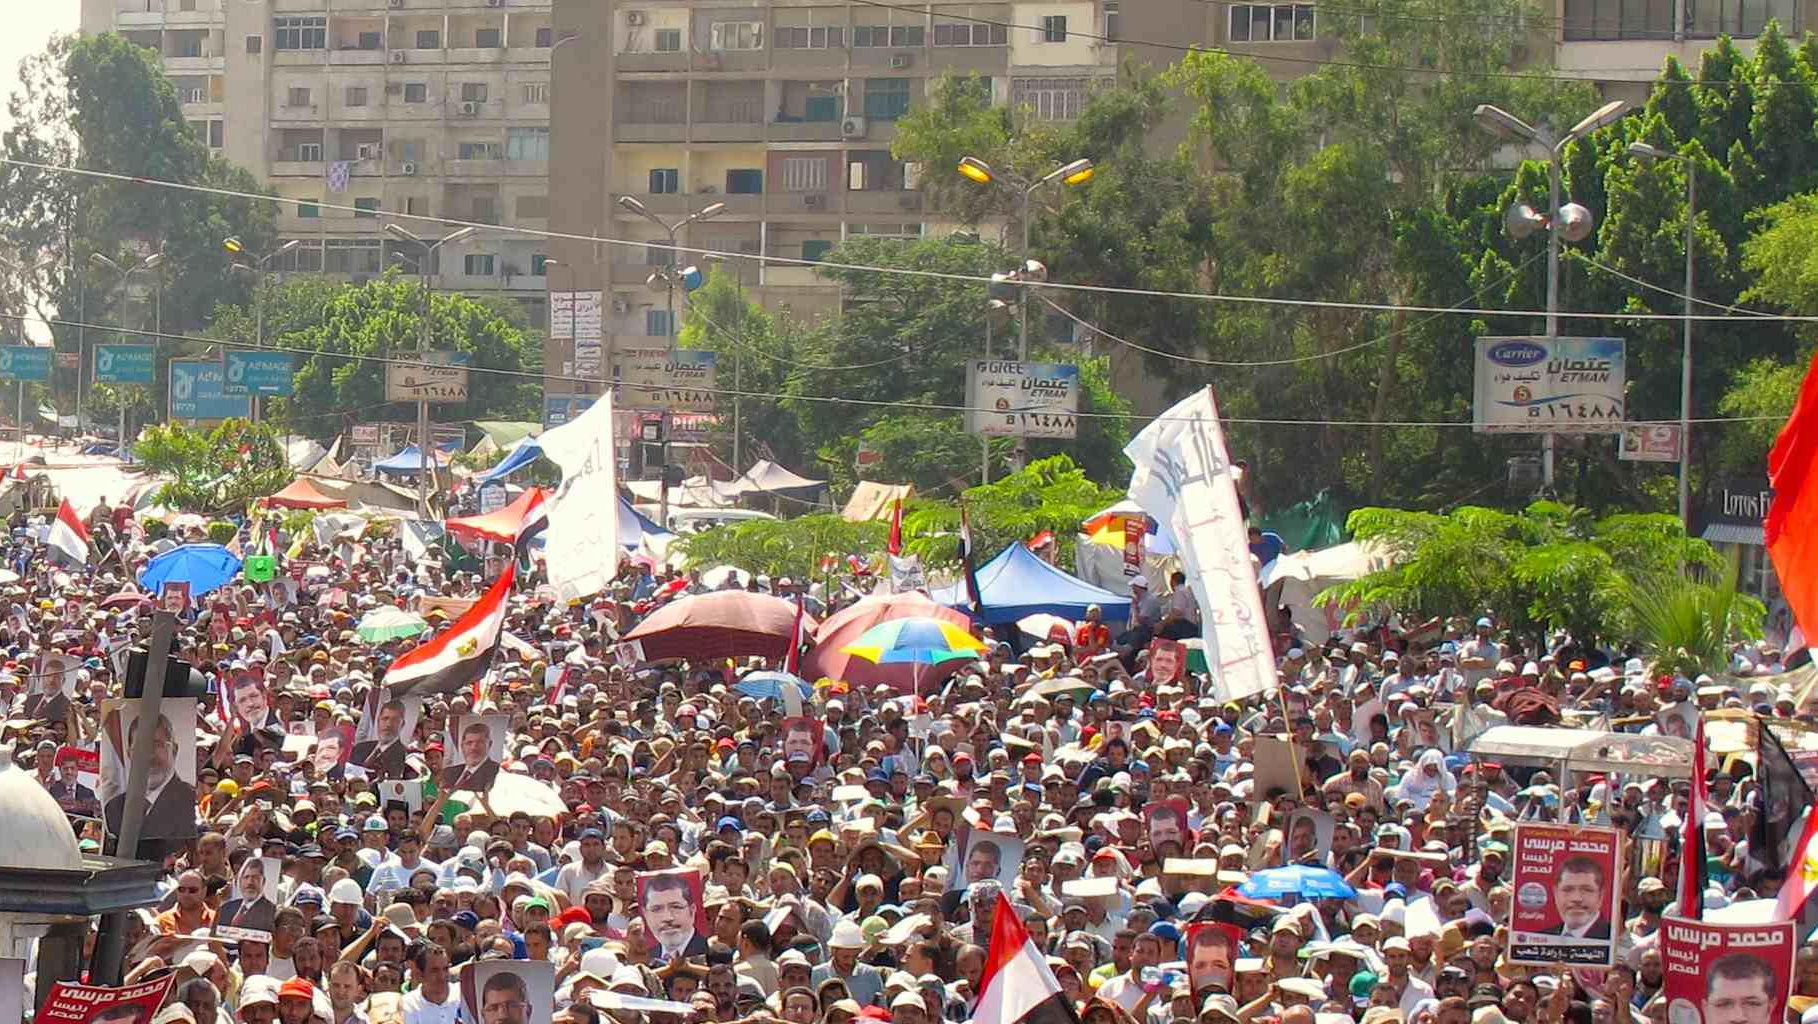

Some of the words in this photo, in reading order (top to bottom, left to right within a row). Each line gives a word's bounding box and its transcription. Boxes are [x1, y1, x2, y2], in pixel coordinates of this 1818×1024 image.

[1494, 345, 1542, 360] Carrier
[1559, 372, 1611, 384] ETMAN
[1726, 929, 1785, 948] محمد
[117, 980, 167, 1001] محمد
